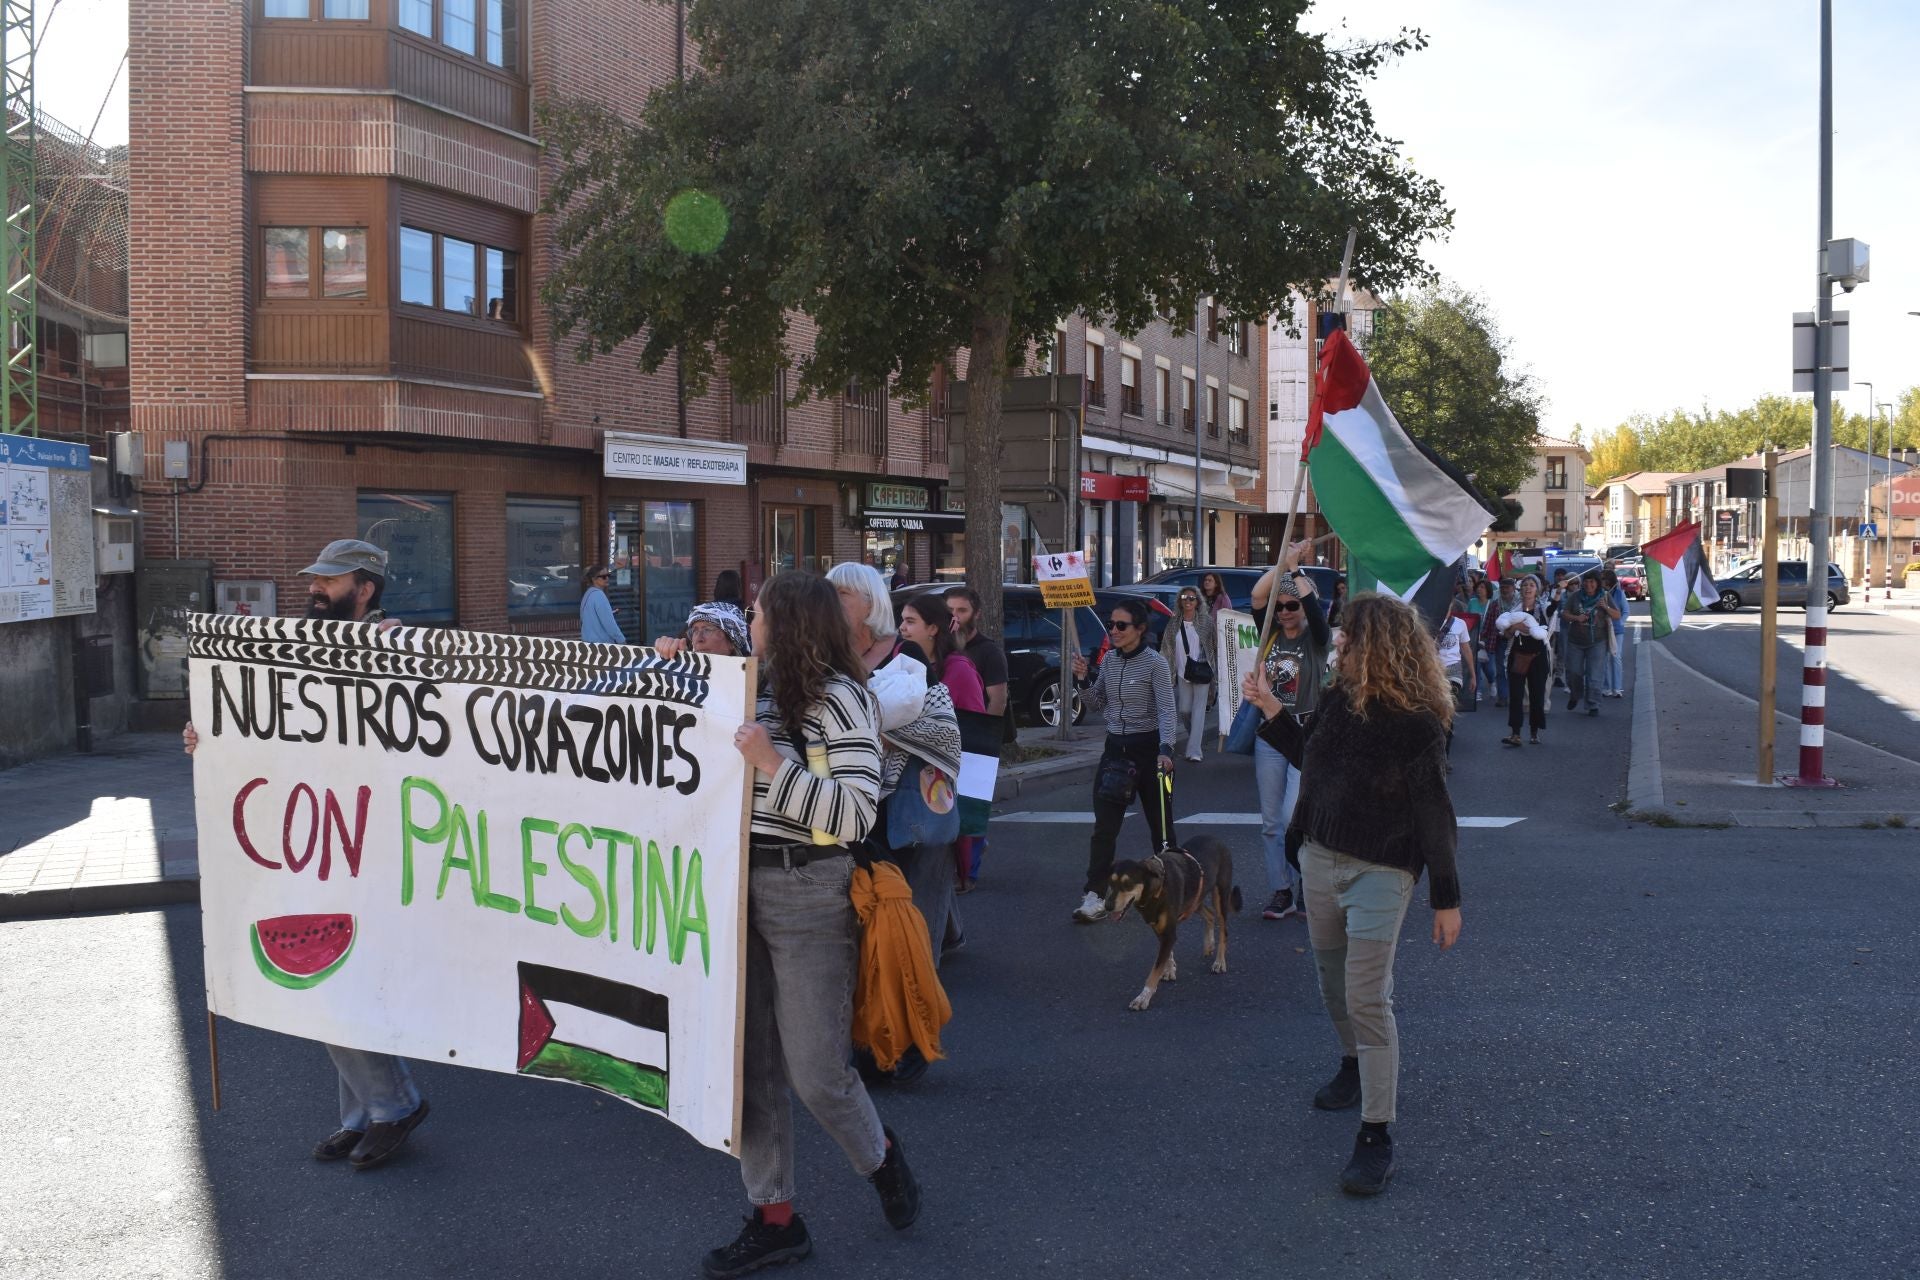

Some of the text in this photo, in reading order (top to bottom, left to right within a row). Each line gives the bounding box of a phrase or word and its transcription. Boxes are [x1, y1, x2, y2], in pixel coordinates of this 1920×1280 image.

[613, 452, 640, 464] CENTRO
[642, 454, 652, 465] DE
[653, 455, 679, 468] MASAJE
[681, 458, 686, 468] Y
[873, 486, 925, 508] CAFETERIA
[869, 517, 899, 529] CAFETERIA
[1069, 591, 1091, 599] GUERRA
[212, 665, 701, 795] NUESTROS CORAZONES
[233, 775, 711, 977] CON PALESTINA
